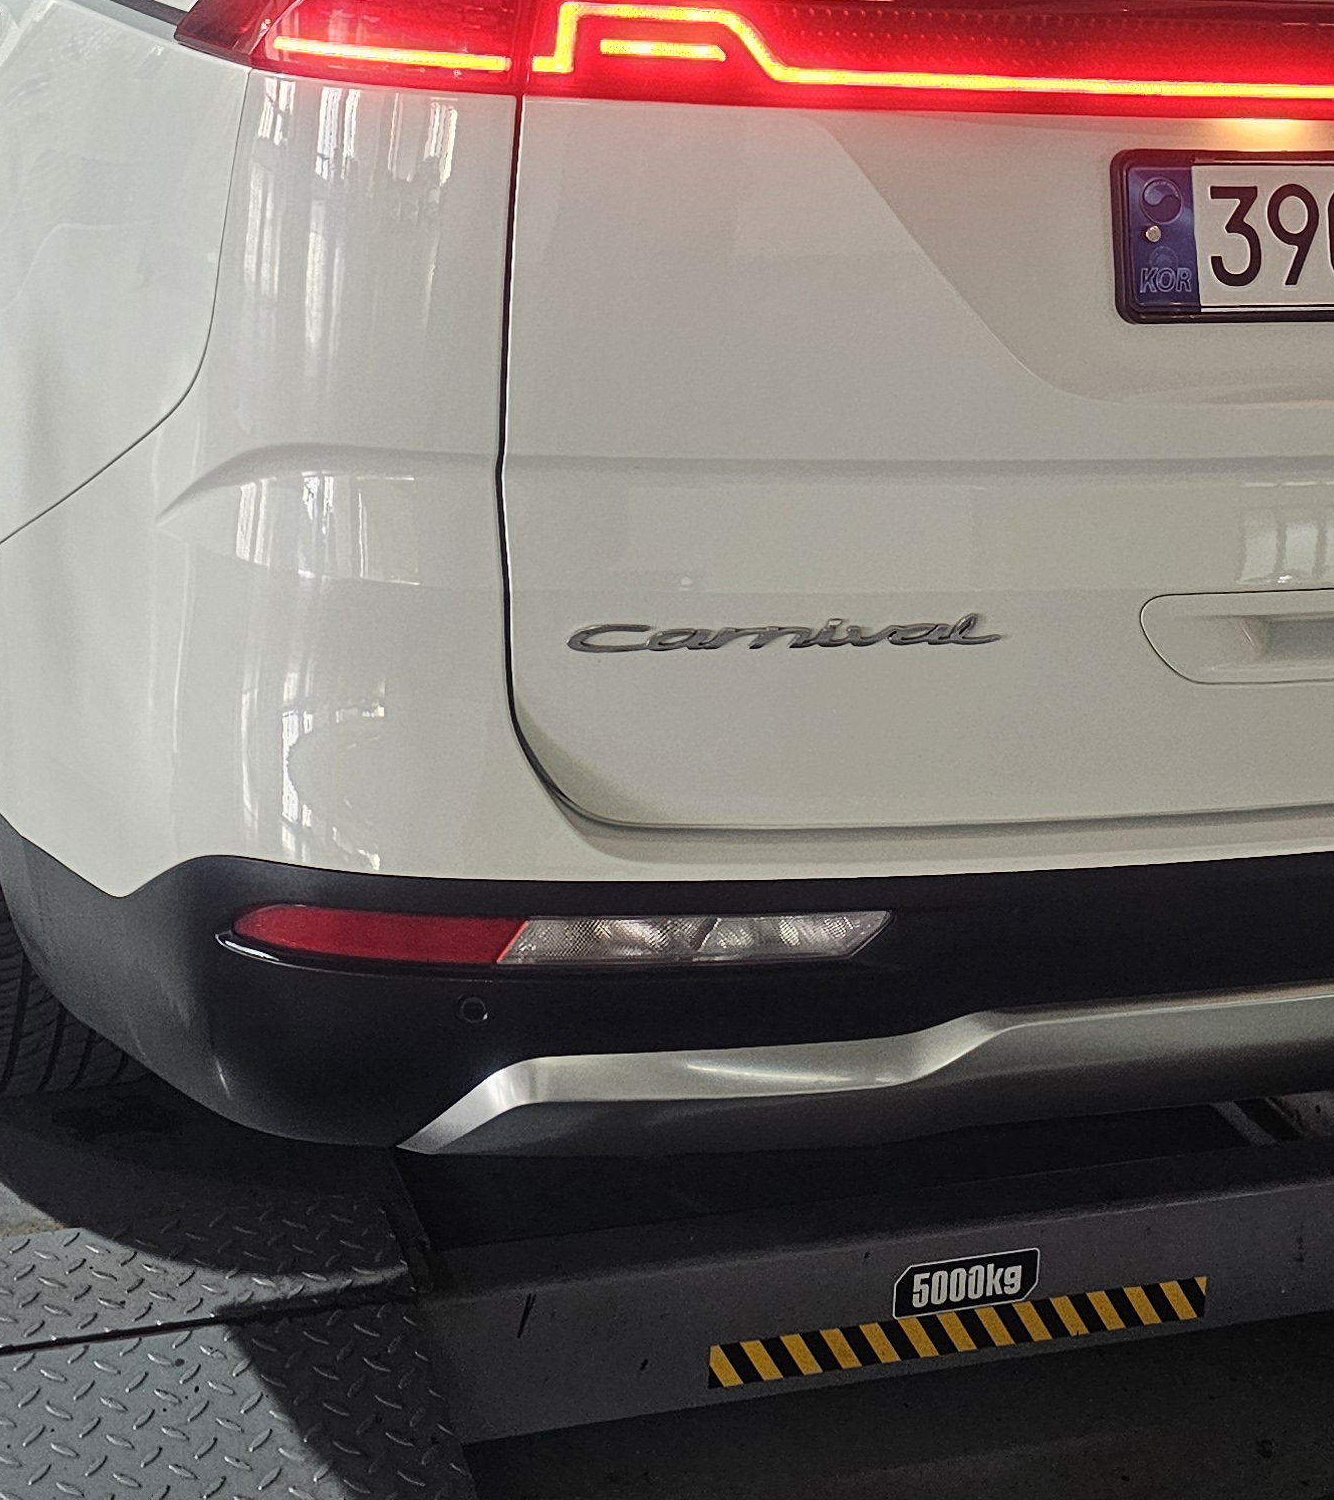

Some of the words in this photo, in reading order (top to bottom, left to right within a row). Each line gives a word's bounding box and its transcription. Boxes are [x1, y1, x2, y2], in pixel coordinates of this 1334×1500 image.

[1139, 266, 1193, 294] KOR
[566, 612, 1005, 653] Carnival
[911, 1263, 1023, 1309] 5000kg
